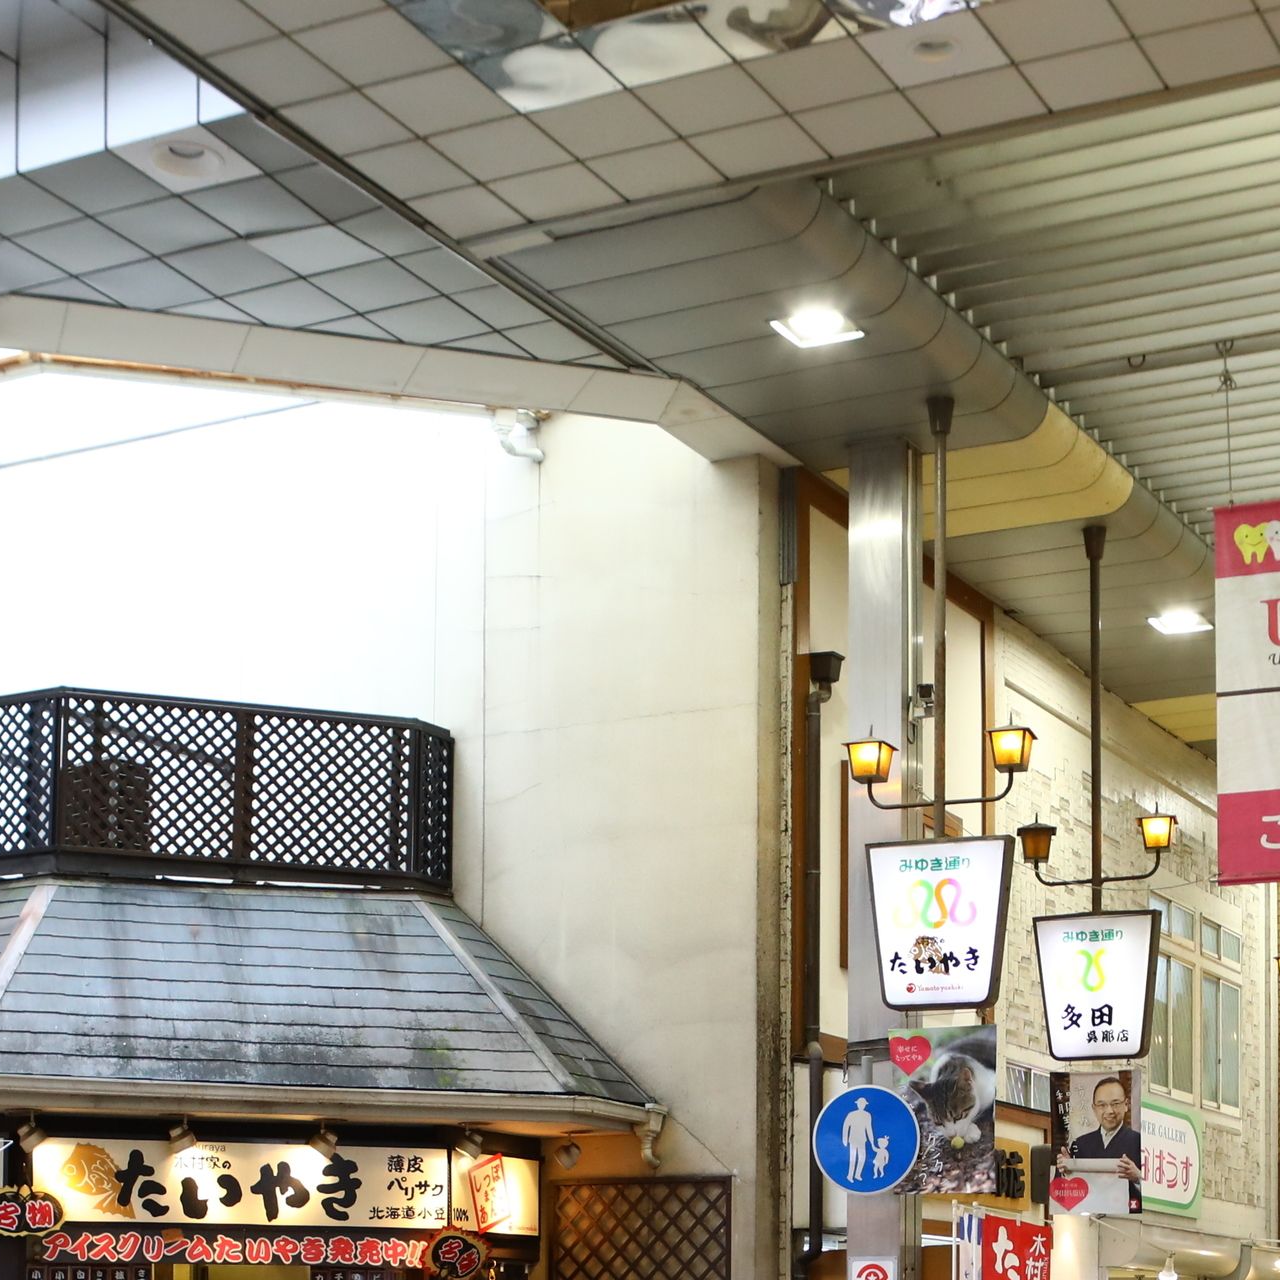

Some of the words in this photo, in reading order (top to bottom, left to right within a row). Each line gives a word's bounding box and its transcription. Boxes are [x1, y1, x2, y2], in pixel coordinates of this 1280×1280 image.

[899, 856, 970, 872] みゆき通り
[1063, 929, 1124, 942] みゆき通り
[889, 946, 980, 975] たいやき
[1061, 1003, 1114, 1030] 多田
[1086, 1029, 1129, 1043] 呉服店
[1157, 1125, 1188, 1145] GALLERY
[387, 1155, 424, 1174] 薄皮
[115, 1149, 362, 1223] たいやき
[387, 1176, 444, 1201] パリサク
[369, 1206, 446, 1221] 北海道小豆
[452, 1208, 469, 1222] 100%
